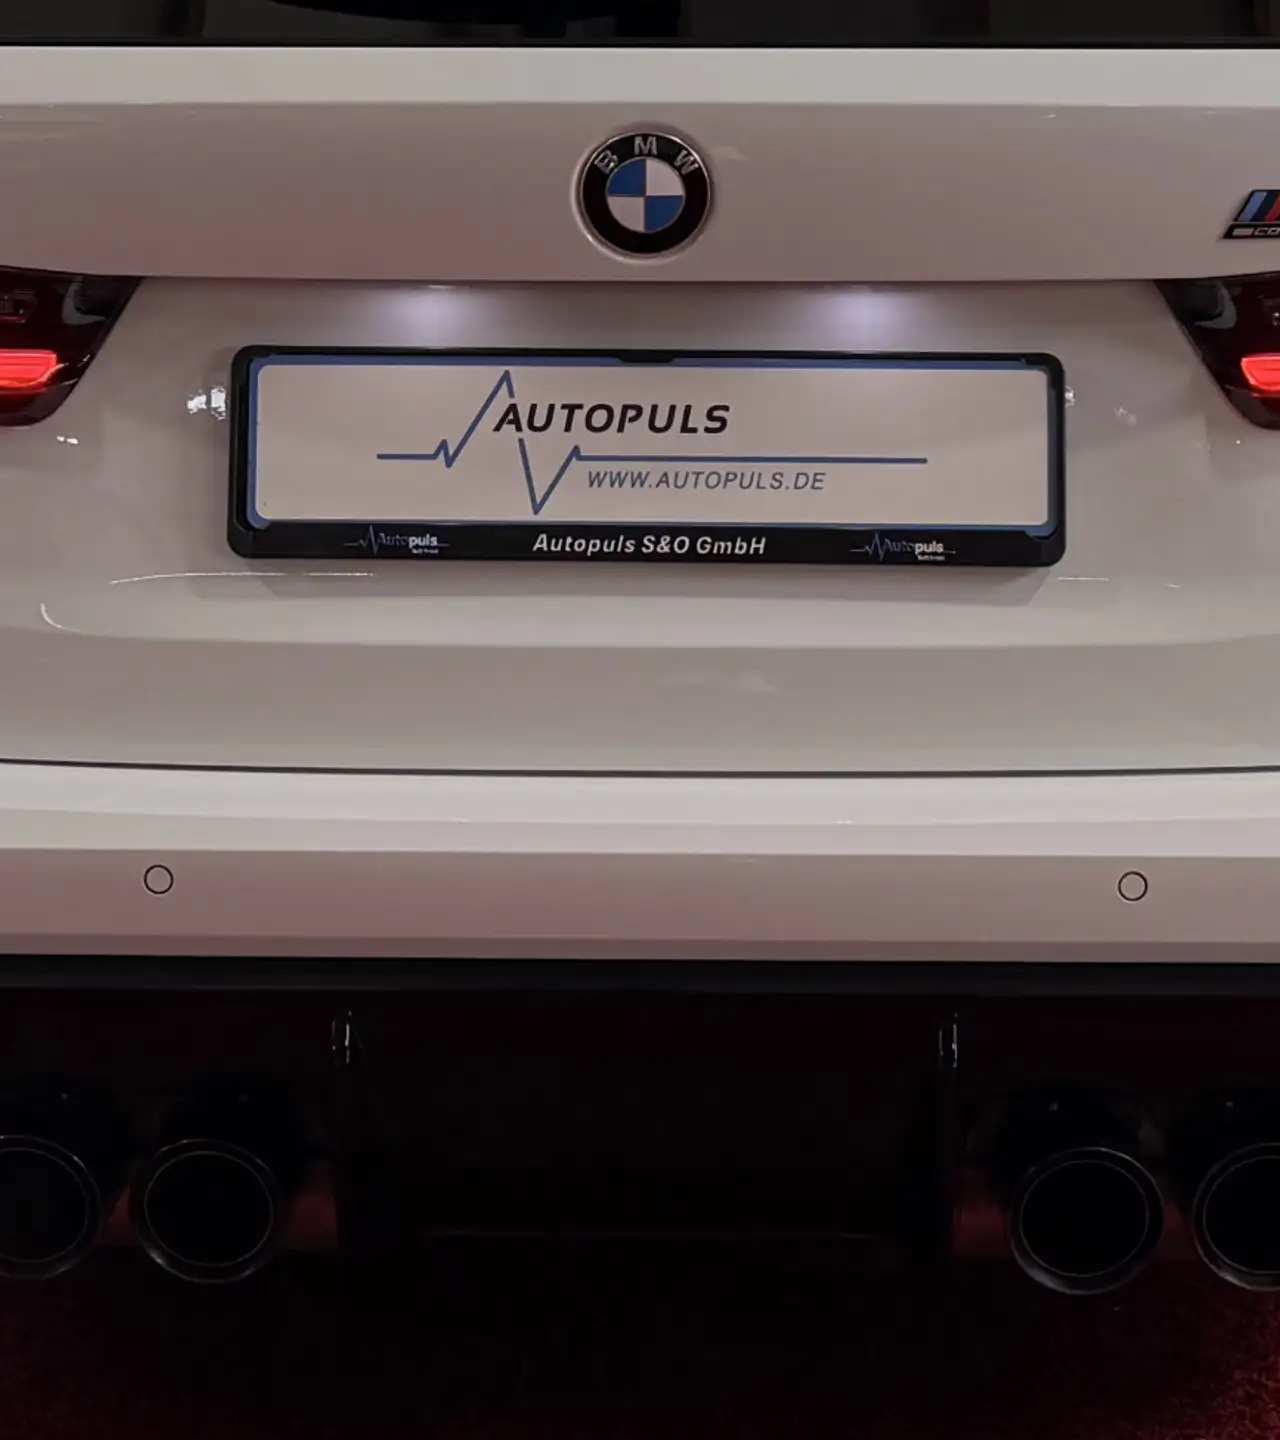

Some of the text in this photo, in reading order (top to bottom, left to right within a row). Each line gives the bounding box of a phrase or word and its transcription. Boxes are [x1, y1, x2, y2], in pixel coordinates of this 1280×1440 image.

[594, 135, 700, 175] BMW
[492, 403, 731, 434] AUTOPULS
[587, 470, 827, 491] WWW.AUTOPULS.DE
[532, 532, 767, 556] Autopuls S&O GmbH
